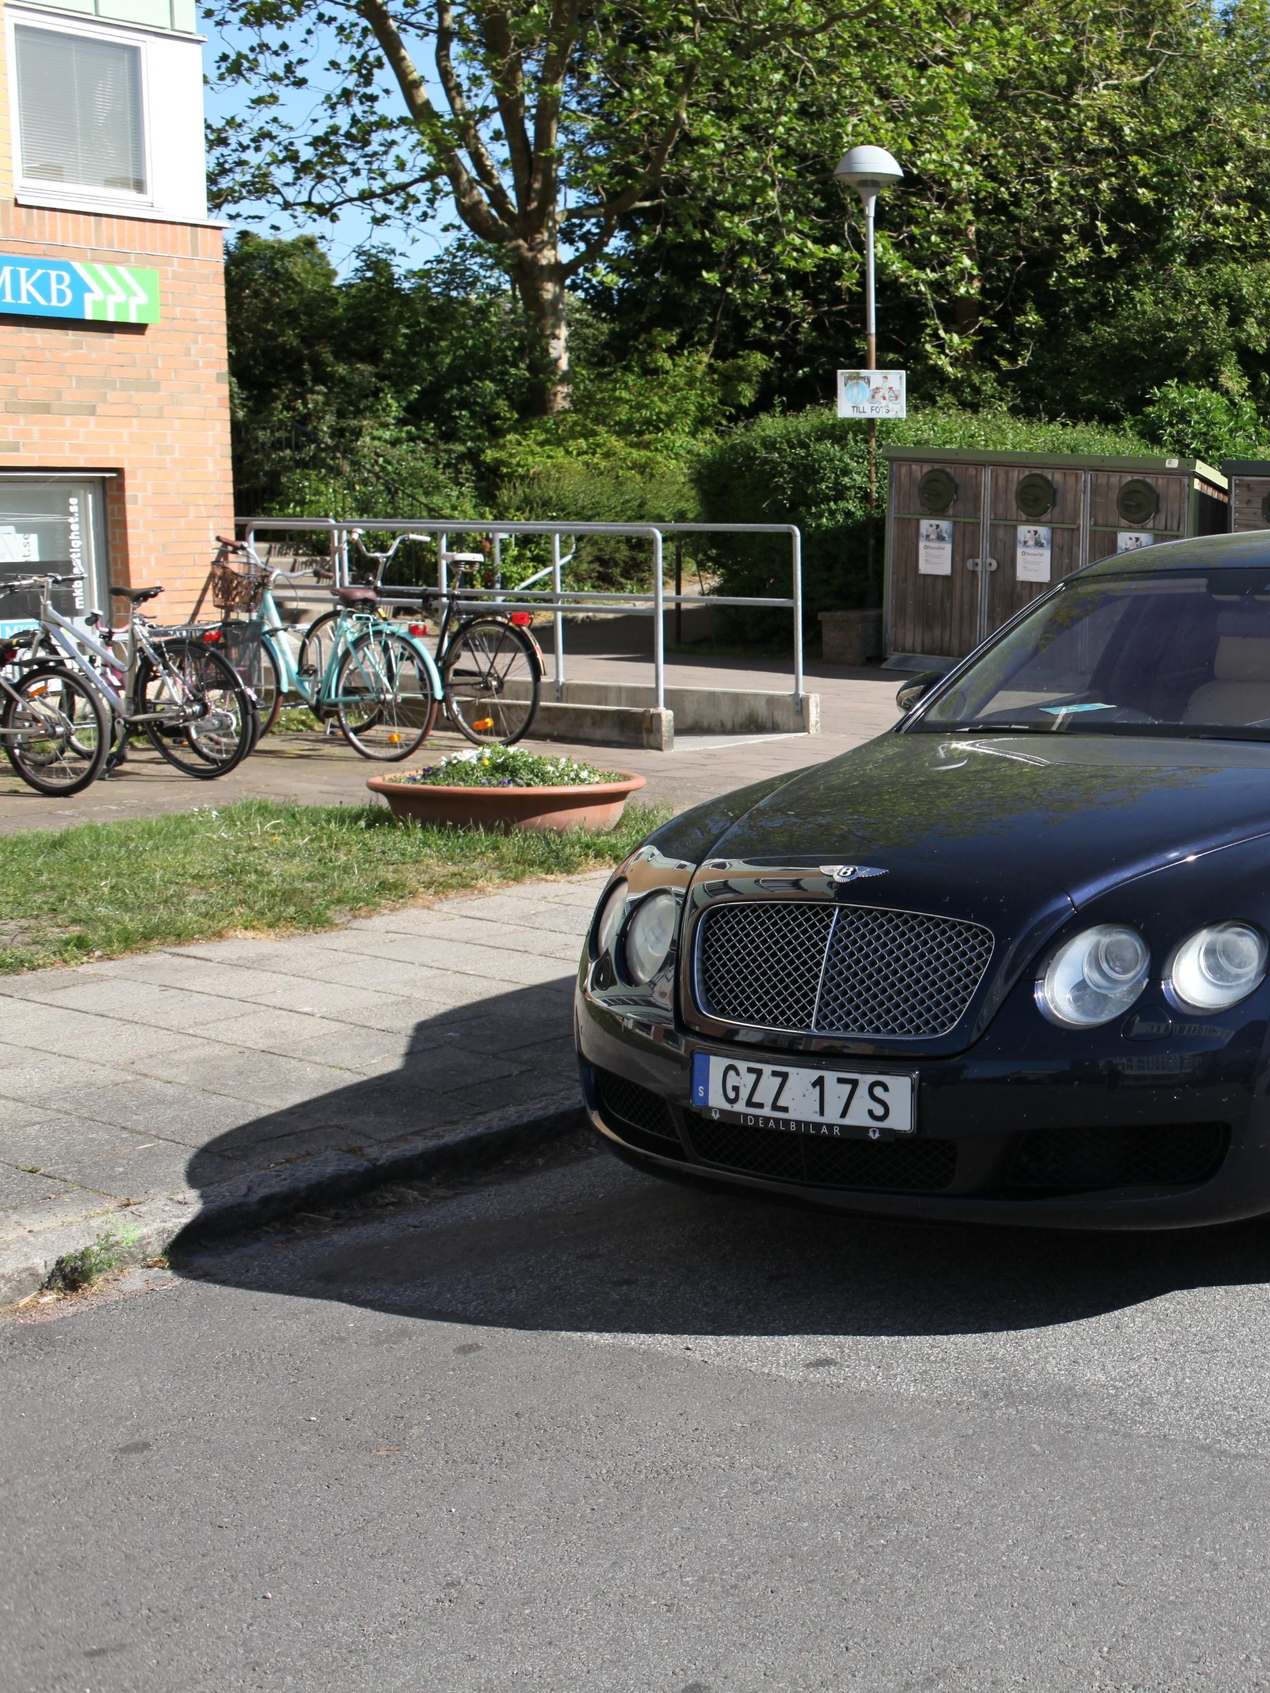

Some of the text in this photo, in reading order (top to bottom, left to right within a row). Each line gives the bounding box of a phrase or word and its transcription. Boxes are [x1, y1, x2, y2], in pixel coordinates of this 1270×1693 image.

[851, 405, 867, 414] TILL
[69, 497, 85, 609] mkbastighet.se
[698, 1086, 704, 1097] S
[721, 1063, 890, 1122] GZZ 17S
[740, 1114, 841, 1136] IDEALBILAR
